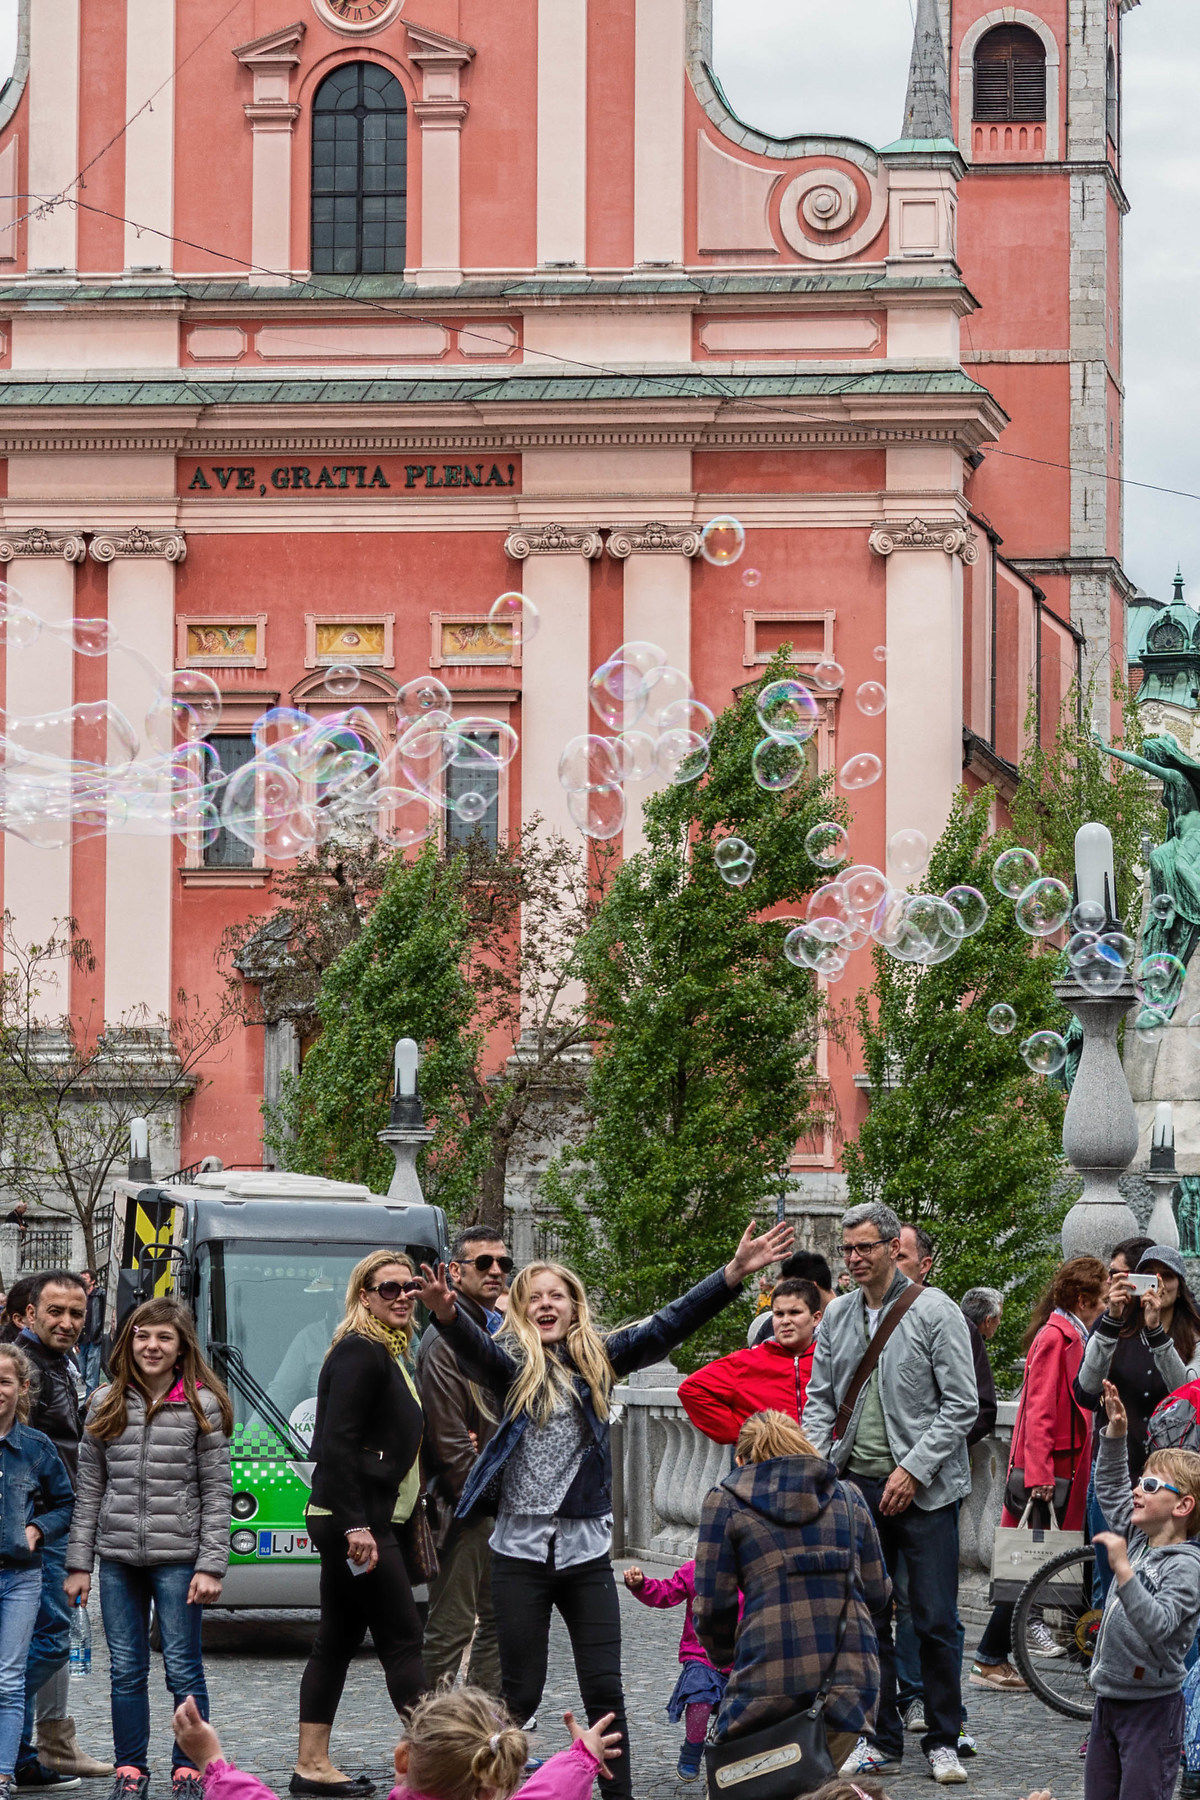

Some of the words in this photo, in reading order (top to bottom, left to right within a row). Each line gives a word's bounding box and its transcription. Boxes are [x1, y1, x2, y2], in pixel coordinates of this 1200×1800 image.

[188, 465, 267, 496] AVE,
[270, 464, 391, 489] GRATIA
[404, 463, 515, 487] PLENA!
[272, 1534, 294, 1553] LJ
